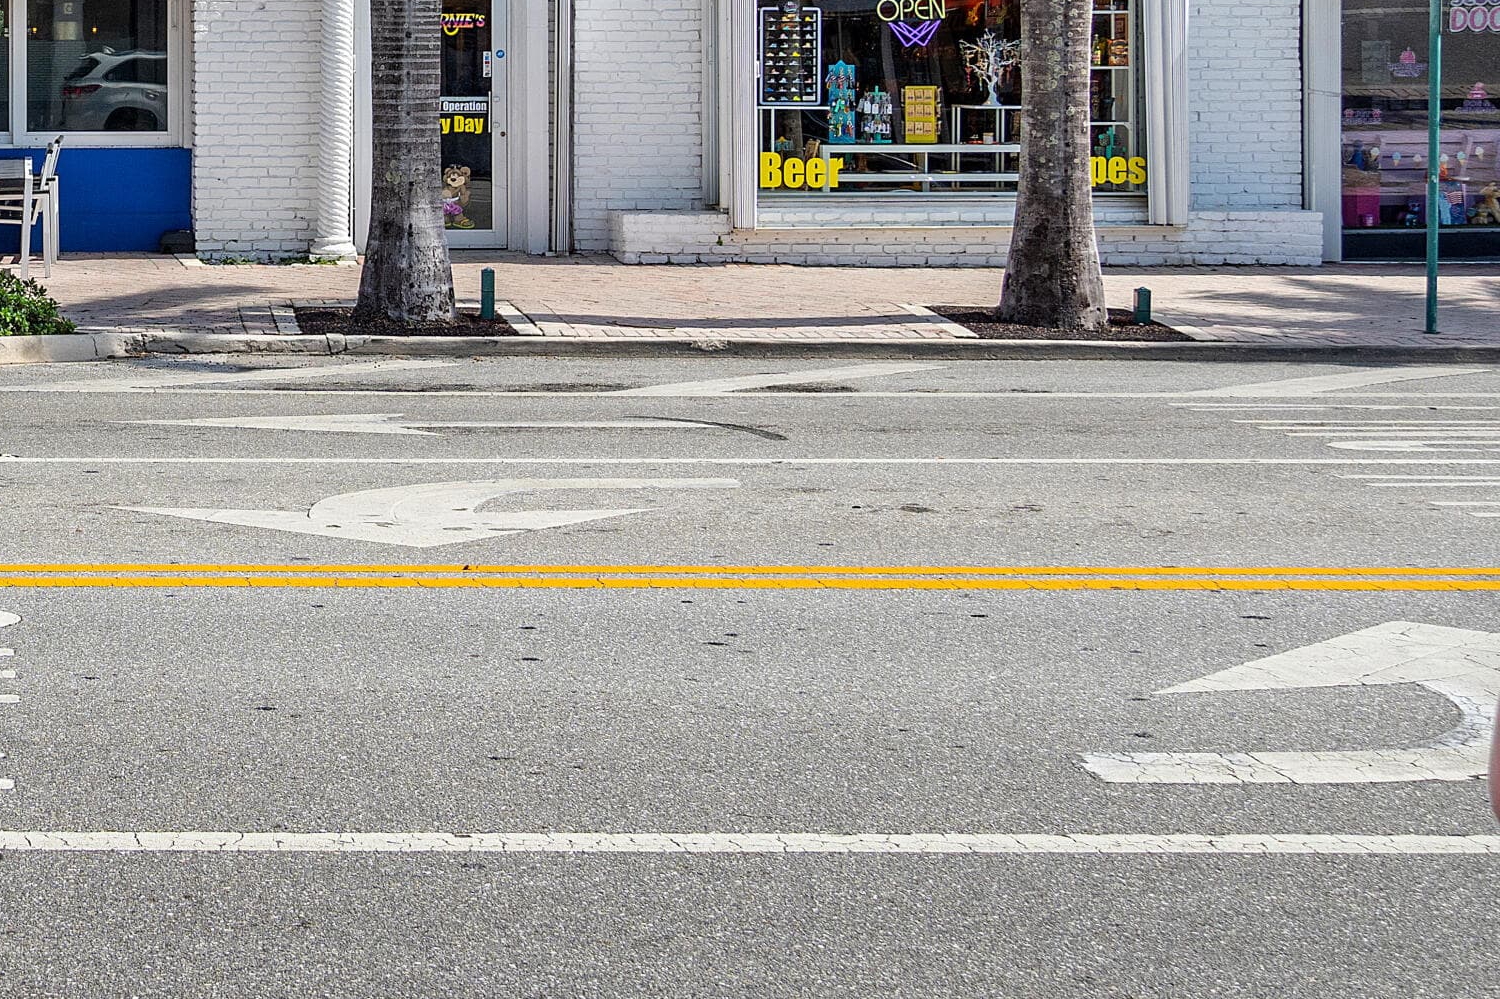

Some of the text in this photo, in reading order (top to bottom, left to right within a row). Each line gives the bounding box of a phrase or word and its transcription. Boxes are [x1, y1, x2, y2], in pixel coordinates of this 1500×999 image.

[441, 13, 485, 36] RNIE'S
[443, 101, 487, 112] Operation
[439, 115, 484, 134] y Day
[759, 151, 1146, 189] Beer pes
